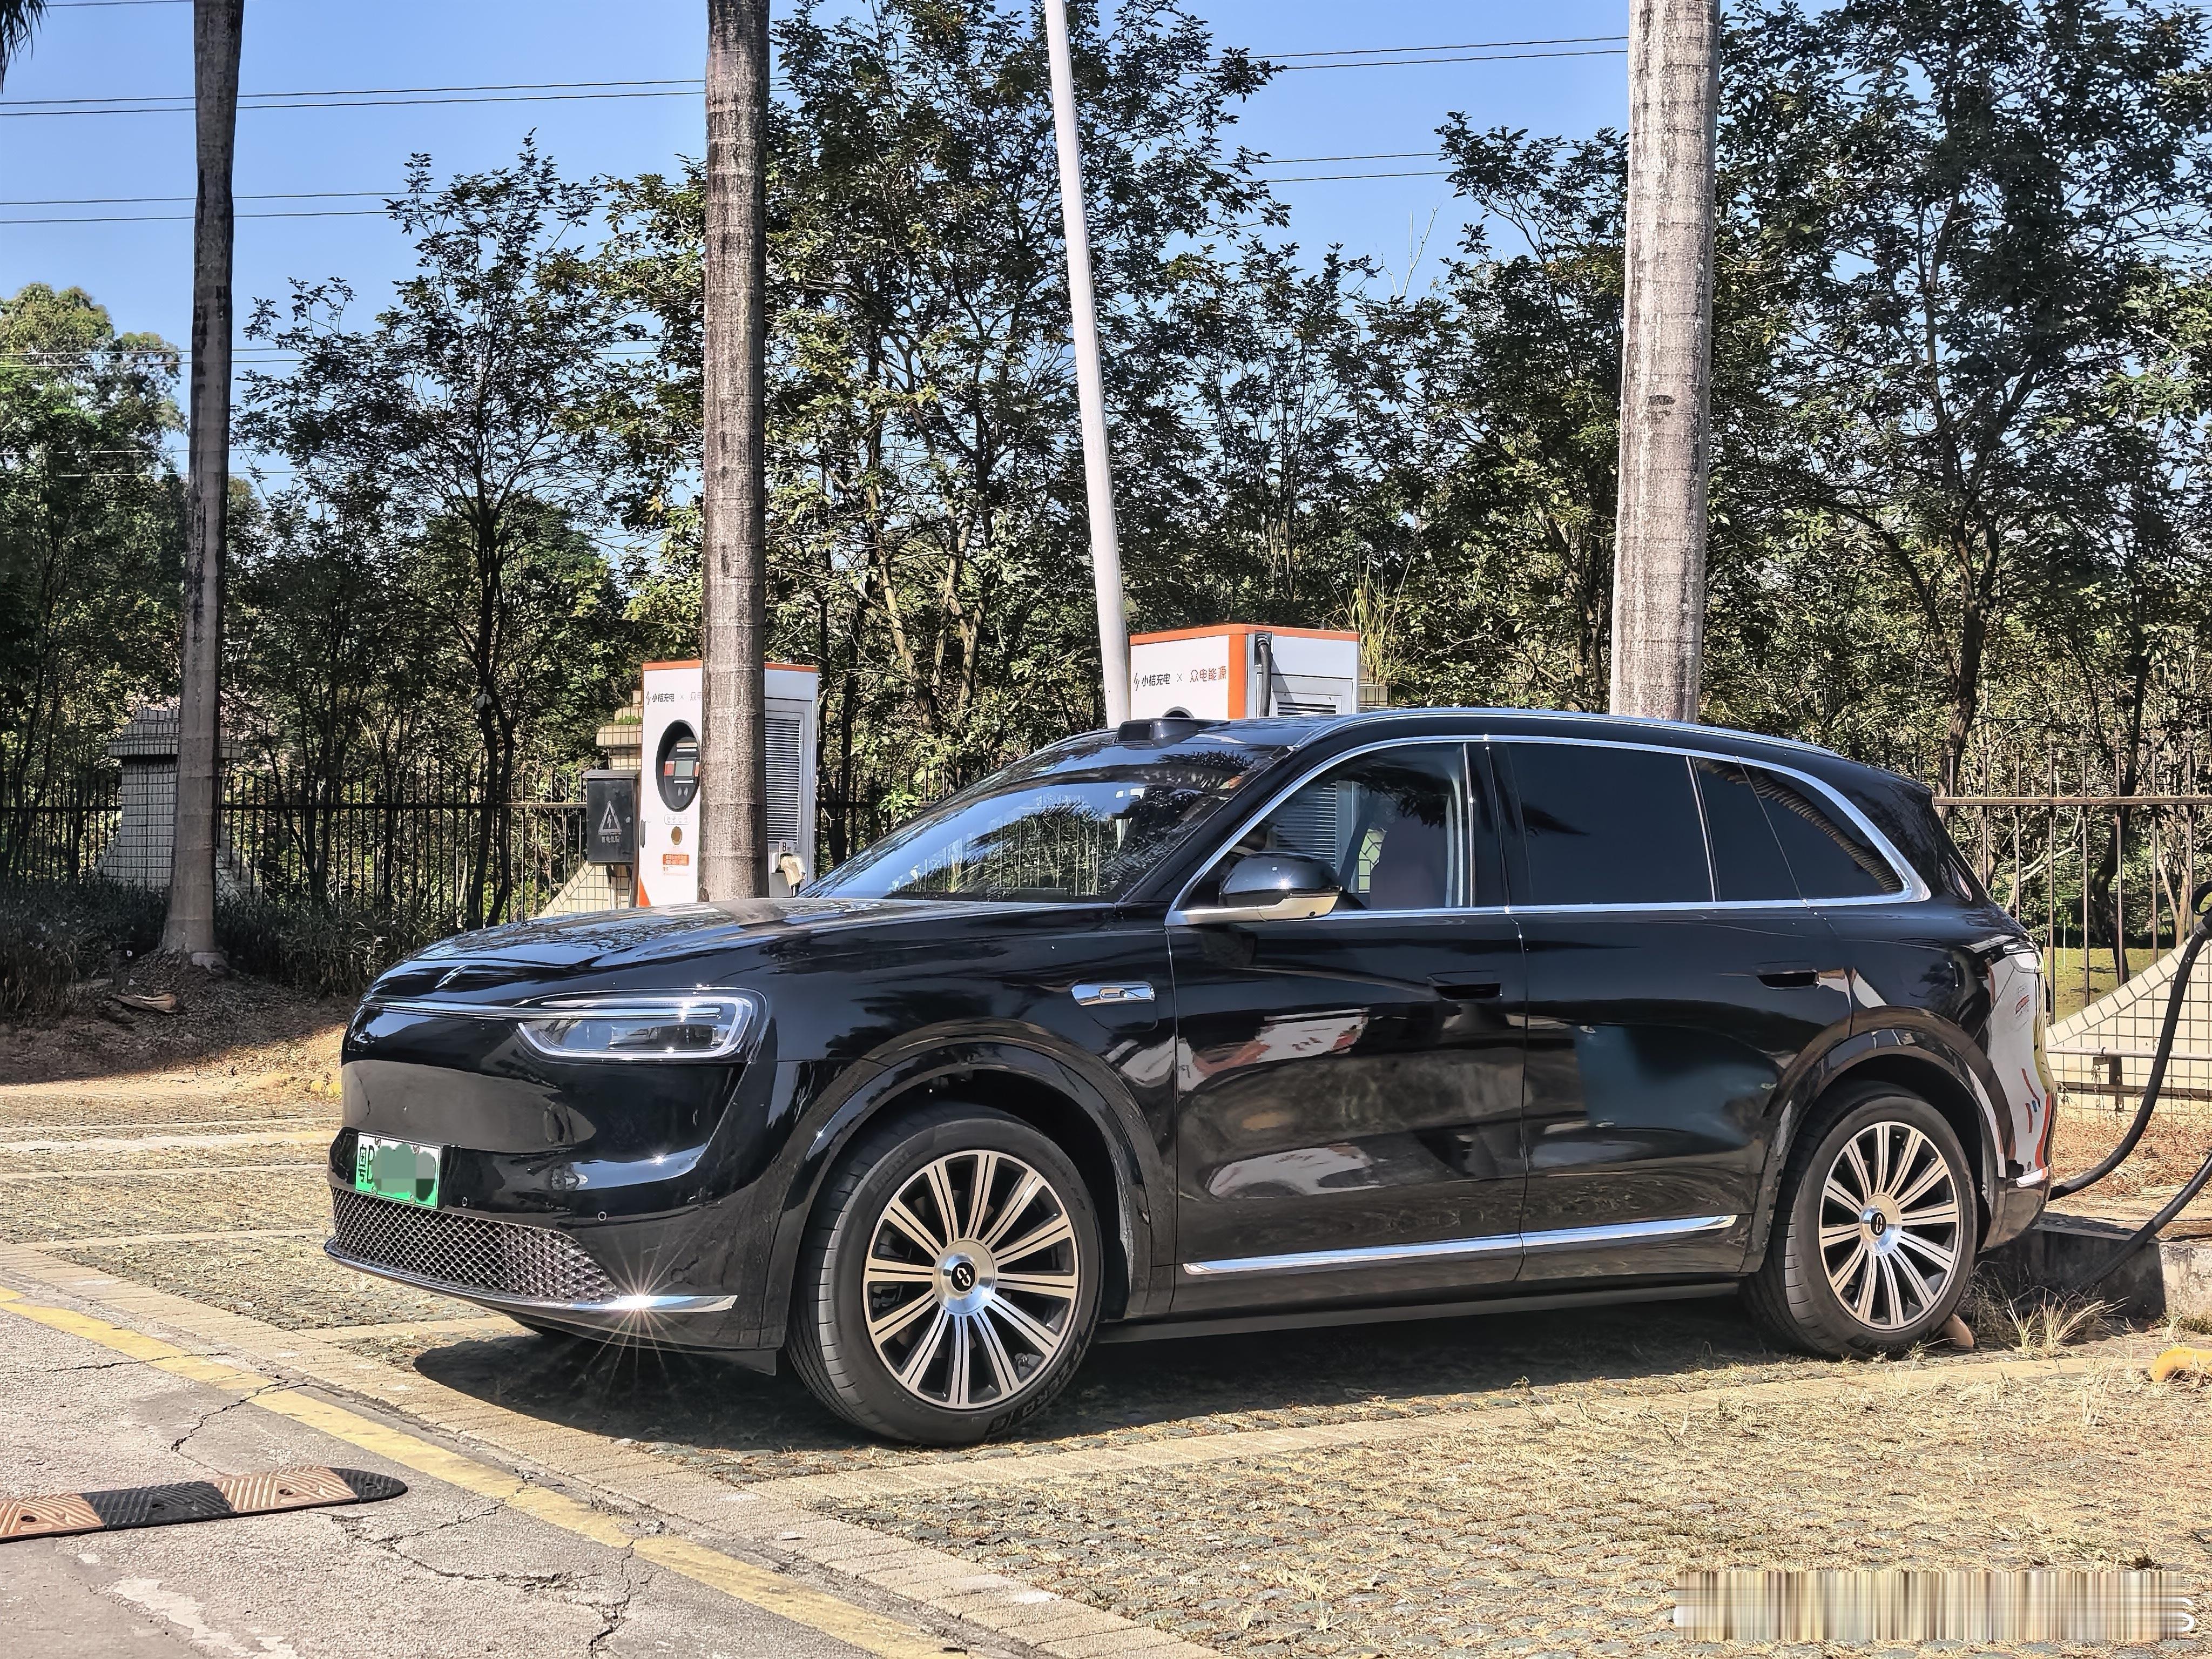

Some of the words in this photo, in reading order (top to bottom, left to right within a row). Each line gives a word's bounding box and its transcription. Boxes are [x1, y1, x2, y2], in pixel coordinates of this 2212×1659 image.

[1141, 673, 1170, 687] 小桔充电
[1190, 666, 1227, 683] 众电能源
